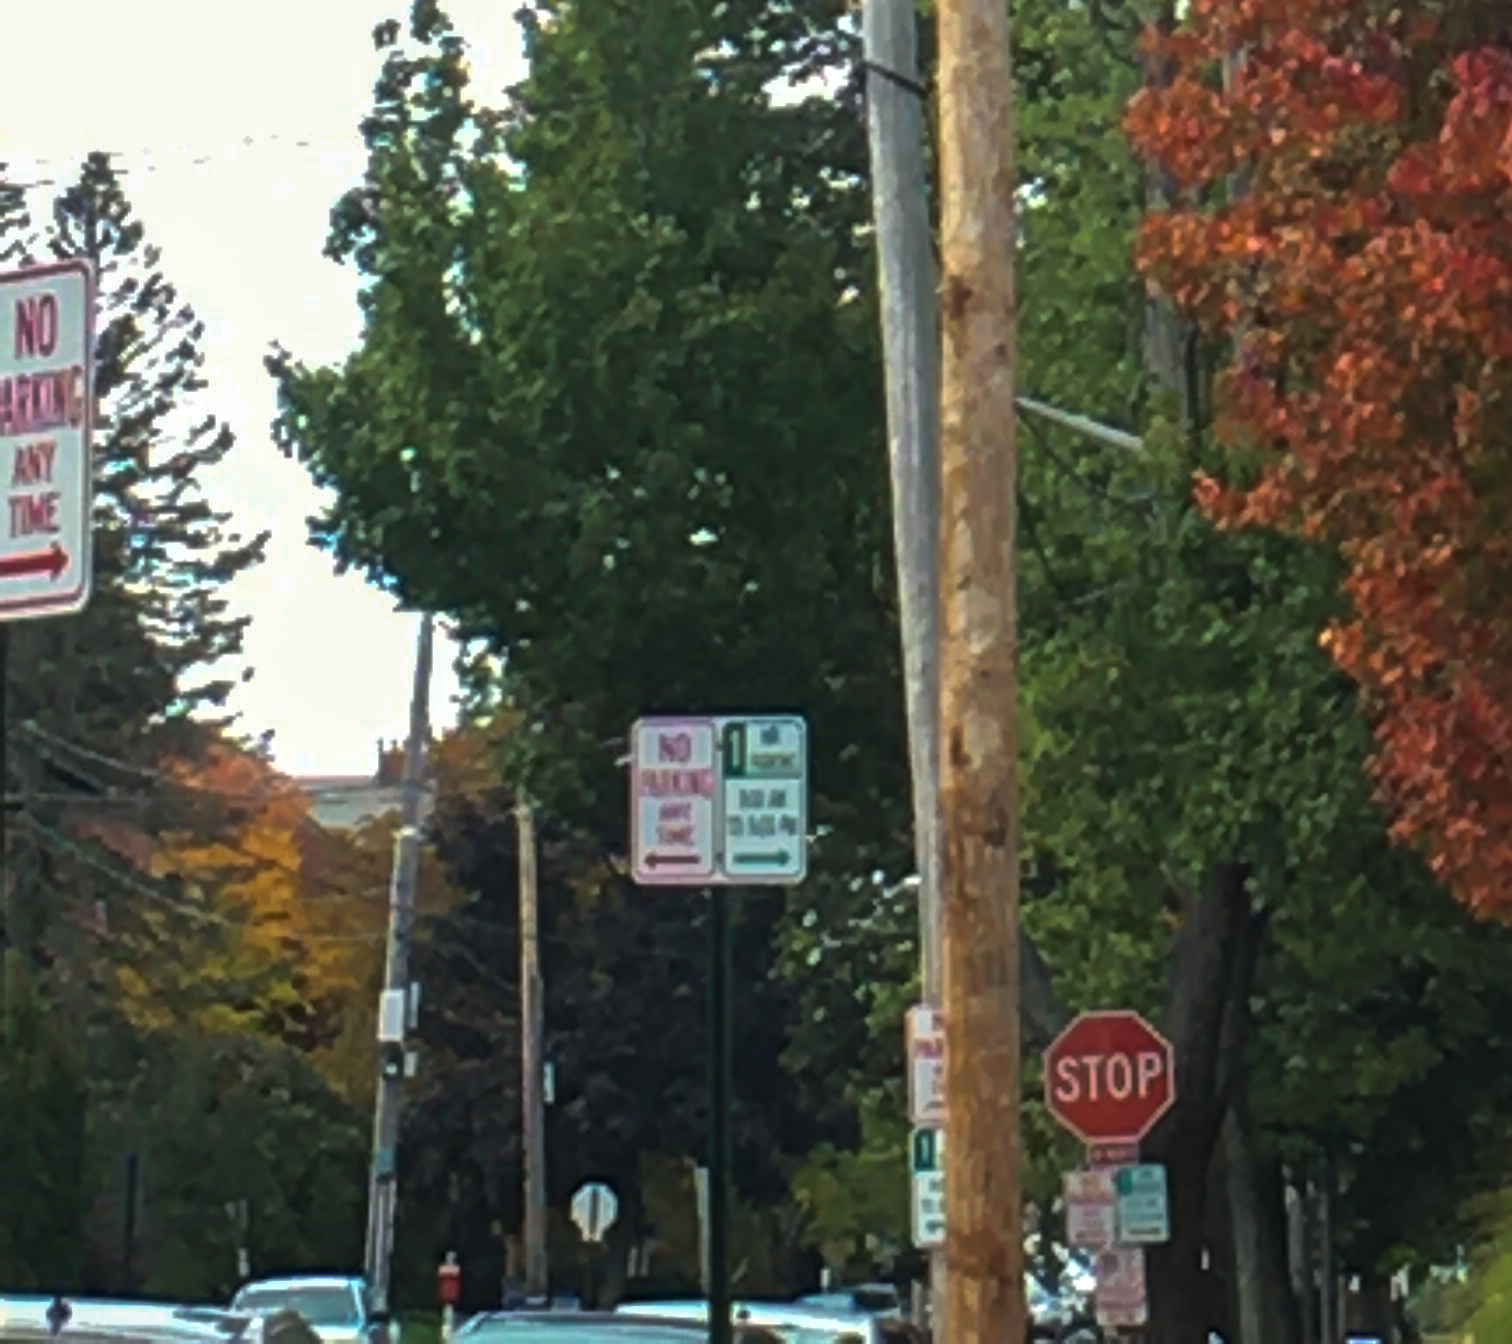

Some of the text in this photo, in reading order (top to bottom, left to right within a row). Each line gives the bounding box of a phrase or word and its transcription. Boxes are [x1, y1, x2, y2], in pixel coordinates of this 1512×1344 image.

[14, 294, 57, 360] NO
[0, 364, 83, 434] ARKING
[12, 438, 57, 486] ANY
[8, 492, 61, 539] TIME
[659, 733, 692, 763] NO
[729, 728, 741, 769] 1
[1056, 1052, 1163, 1103] STOP
